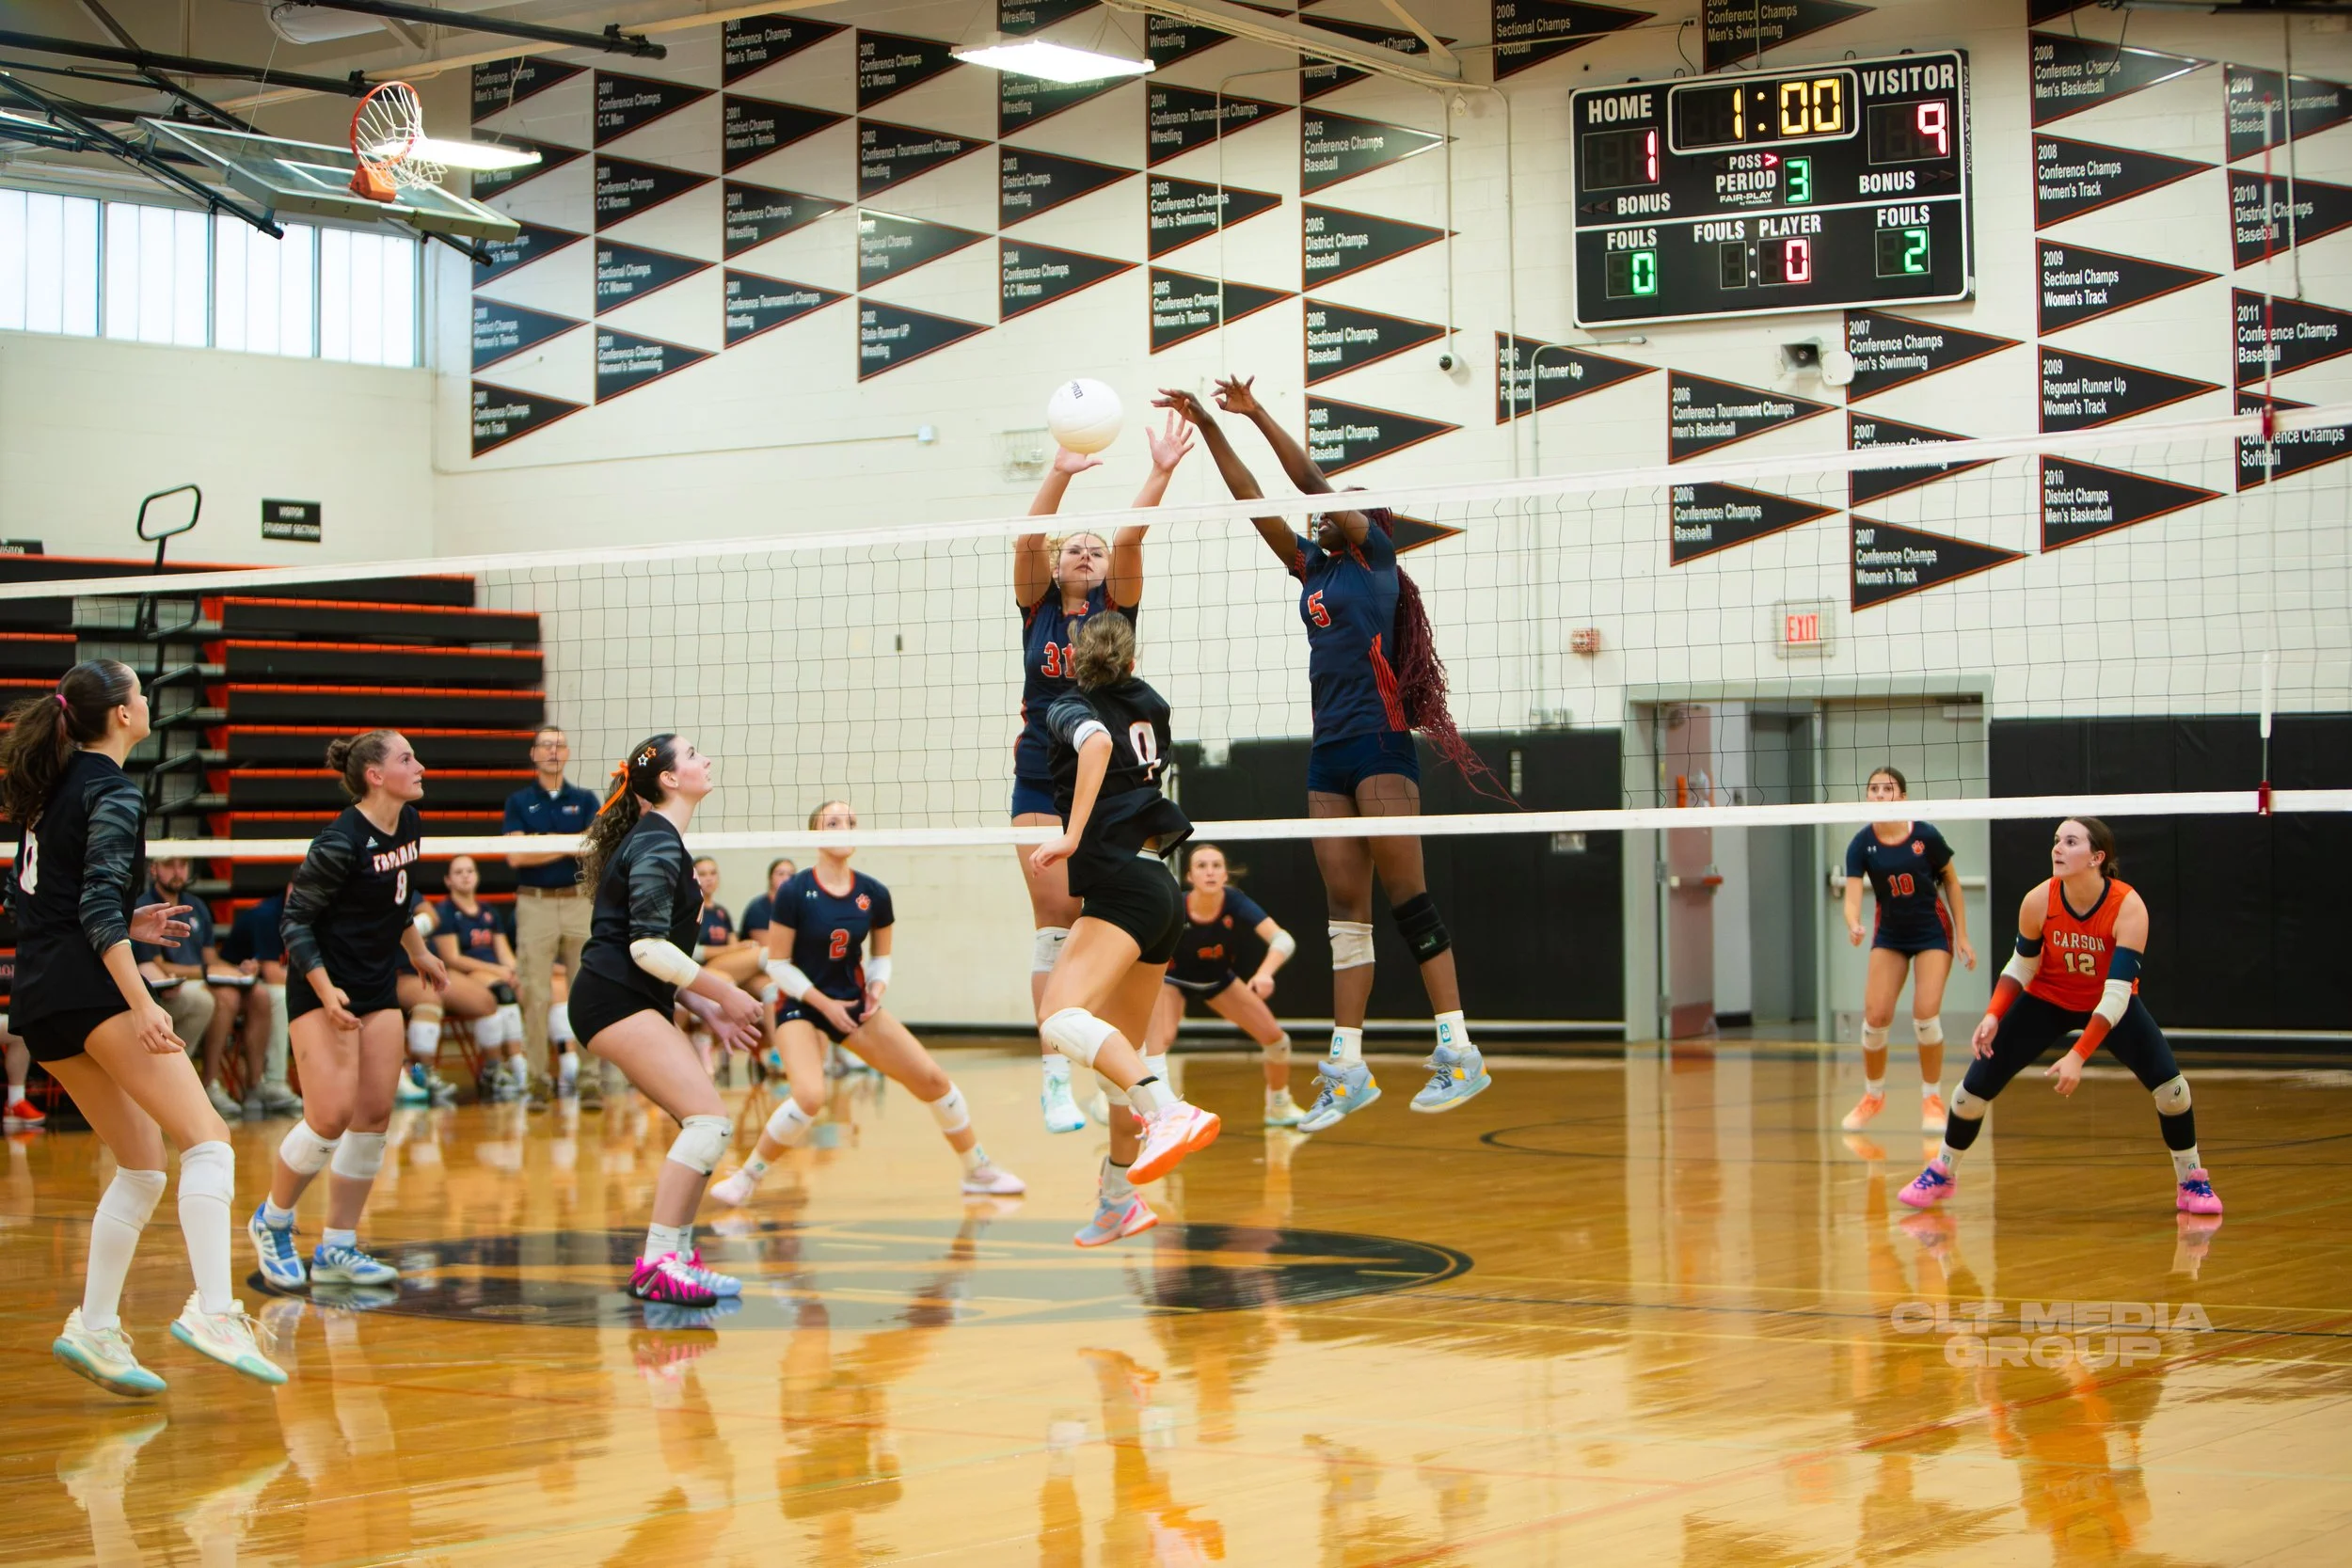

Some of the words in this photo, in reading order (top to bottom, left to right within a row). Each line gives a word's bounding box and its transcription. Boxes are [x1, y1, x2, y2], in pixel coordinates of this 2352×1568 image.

[1002, 9, 1035, 24] Wrestling
[1496, 4, 1516, 20] 2006
[1497, 21, 1535, 38] Sectional
[1536, 17, 1571, 33] Champs
[726, 33, 762, 48] Conference
[765, 27, 792, 42] Champs
[1150, 33, 1185, 48] Wrestling
[1497, 40, 1531, 56] Football
[2034, 45, 2054, 60] 2008
[860, 56, 895, 72] Conference
[896, 53, 922, 69] Champs
[2035, 63, 2082, 80] Conference
[2086, 59, 2121, 75] Champs
[1863, 64, 1955, 96] VISITOR
[2036, 83, 2059, 99] Men's
[2061, 77, 2105, 96] Basketball
[598, 96, 635, 112] Conference
[635, 92, 661, 107] Champs
[1002, 100, 1032, 115] Wrestling
[1151, 94, 1167, 108] 2004
[1588, 94, 1652, 123] HOME
[1733, 78, 1840, 140] 1:00
[1151, 129, 1183, 145] Wrestling
[1304, 121, 1323, 136] 2005
[1917, 101, 1947, 155] 9
[862, 145, 896, 161] Conference
[897, 141, 933, 156] Tournament
[934, 138, 961, 153] Champs
[1304, 138, 1349, 155] Conference
[1351, 135, 1384, 151] Champs
[2038, 143, 2058, 160] 2008
[1304, 155, 1338, 173] Baseball
[1646, 130, 1657, 182] 1
[1729, 153, 1762, 170] POSS
[862, 164, 890, 179] Wrestling
[2039, 162, 2086, 180] Conference
[2087, 159, 2122, 177] Champs
[1003, 173, 1025, 189] District
[1025, 171, 1051, 187] Champs
[1151, 182, 1169, 196] 2005
[1715, 169, 1777, 194] PERIOD
[1786, 159, 1809, 202] 3
[1859, 170, 1915, 194] BONUS
[1003, 191, 1032, 207] Wrestling
[2039, 183, 2077, 200] Women's
[2078, 180, 2102, 197] Track
[2233, 184, 2257, 202] 2010
[727, 207, 764, 223] Conference
[764, 203, 792, 219] Champs
[1617, 193, 1671, 214] BONUS
[1151, 214, 1174, 229] Men's
[1176, 209, 1216, 226] Swimming
[1305, 217, 1325, 232] 2005
[1876, 204, 1931, 228] FOULS
[1693, 220, 1745, 243] FOULS
[1758, 214, 1821, 238] PLAYER
[2236, 223, 2280, 243] Baseball
[861, 236, 887, 253] Regional
[887, 233, 913, 249] Champs
[1305, 234, 1334, 250] District
[1335, 232, 1369, 249] Champs
[1607, 229, 1658, 250] FOULS
[1003, 251, 1019, 265] 2004
[1305, 251, 1340, 268] Baseball
[1786, 238, 1809, 282] 0
[1903, 229, 1927, 273] 2
[2043, 250, 2063, 266] 2009
[1003, 265, 1041, 281] Conference
[1041, 262, 1070, 278] Champs
[1632, 252, 1654, 294] 0
[2044, 270, 2083, 287] Sectional
[2084, 268, 2119, 285] Champs
[1152, 280, 1170, 294] 2005
[2044, 291, 2082, 308] Women's
[2083, 288, 2107, 305] Track
[1153, 312, 1186, 326] Women's
[1187, 309, 1210, 324] Tennis
[1307, 311, 1327, 326] 2005
[2237, 305, 2259, 322] 2011
[877, 325, 899, 339] Runner
[1307, 328, 1343, 345] Sectional
[1344, 326, 1378, 343] Champs
[1849, 320, 1870, 336] 2007
[597, 348, 634, 362] Conference
[634, 344, 664, 359] Champs
[1850, 337, 1902, 354] Conference
[1904, 334, 1944, 353] Champs
[2238, 344, 2281, 363] Baseball
[1308, 346, 1342, 363] Baseball
[597, 360, 628, 374] Women's
[628, 356, 664, 372] Swimming
[2043, 358, 2063, 374] 2009
[1673, 388, 1691, 403] 2006
[2043, 379, 2080, 397] Regional
[2081, 377, 2113, 394] Runner
[2114, 376, 2126, 394] Up
[1309, 408, 1328, 423] 2005
[1673, 404, 1716, 420] Conference
[1717, 402, 1762, 418] Tournament
[1763, 400, 1794, 418] Champs
[2043, 400, 2082, 416] Women's
[2083, 397, 2106, 414] Track
[1309, 425, 1344, 445] Regional
[1345, 423, 1379, 442] Champs
[1673, 423, 1694, 438] men's
[1696, 420, 1736, 437] Basketball
[1854, 424, 1876, 439] 2007
[2302, 427, 2345, 446] Champs
[1310, 442, 1344, 460] Baseball
[2044, 469, 2064, 485] 2010
[2044, 488, 2074, 504] District
[2075, 486, 2108, 504] Champs
[1674, 505, 1724, 520] Conference
[1725, 502, 1762, 520] Champs
[2044, 508, 2069, 524] Men's
[2070, 505, 2113, 523] Basketball
[1674, 524, 1712, 541] Baseball
[1855, 529, 1875, 545] 2007
[1856, 547, 1902, 563] Conference
[1903, 546, 1938, 565] Champs
[1856, 568, 1894, 585] Women's
[1895, 566, 1918, 583] Track
[1308, 589, 1331, 628] 5
[1787, 614, 1818, 641] EXIT
[394, 869, 407, 906] 8
[1887, 873, 1915, 897] 10
[829, 927, 850, 960] 2
[2053, 930, 2106, 952] CARSON
[2064, 952, 2097, 975] 12
